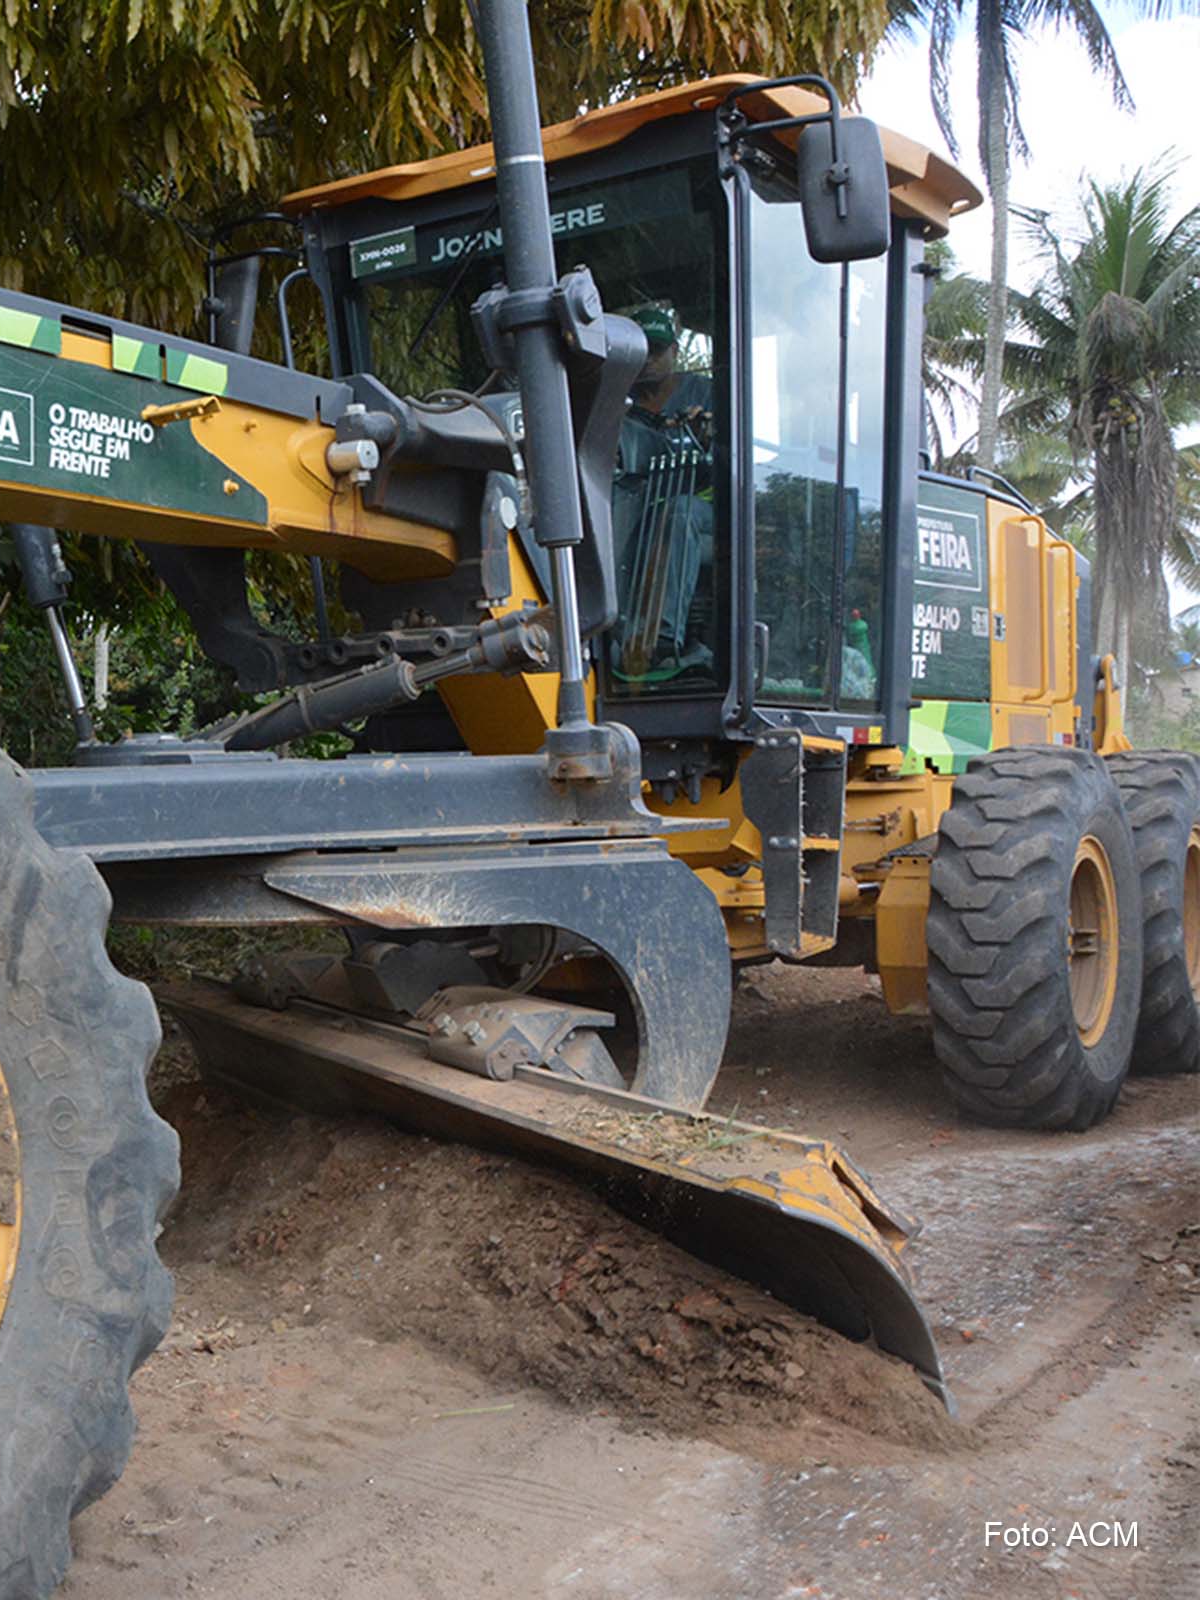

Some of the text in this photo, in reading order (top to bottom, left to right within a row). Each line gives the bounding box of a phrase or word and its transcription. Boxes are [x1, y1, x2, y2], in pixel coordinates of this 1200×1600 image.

[550, 203, 606, 234] ERE
[49, 403, 154, 443] O TRABALHO
[49, 425, 103, 455] SEGUE
[105, 437, 130, 460] EM
[49, 447, 111, 478] FRENTE
[918, 528, 972, 570] FEIRA
[912, 603, 960, 631] BALHO
[921, 629, 942, 654] EM
